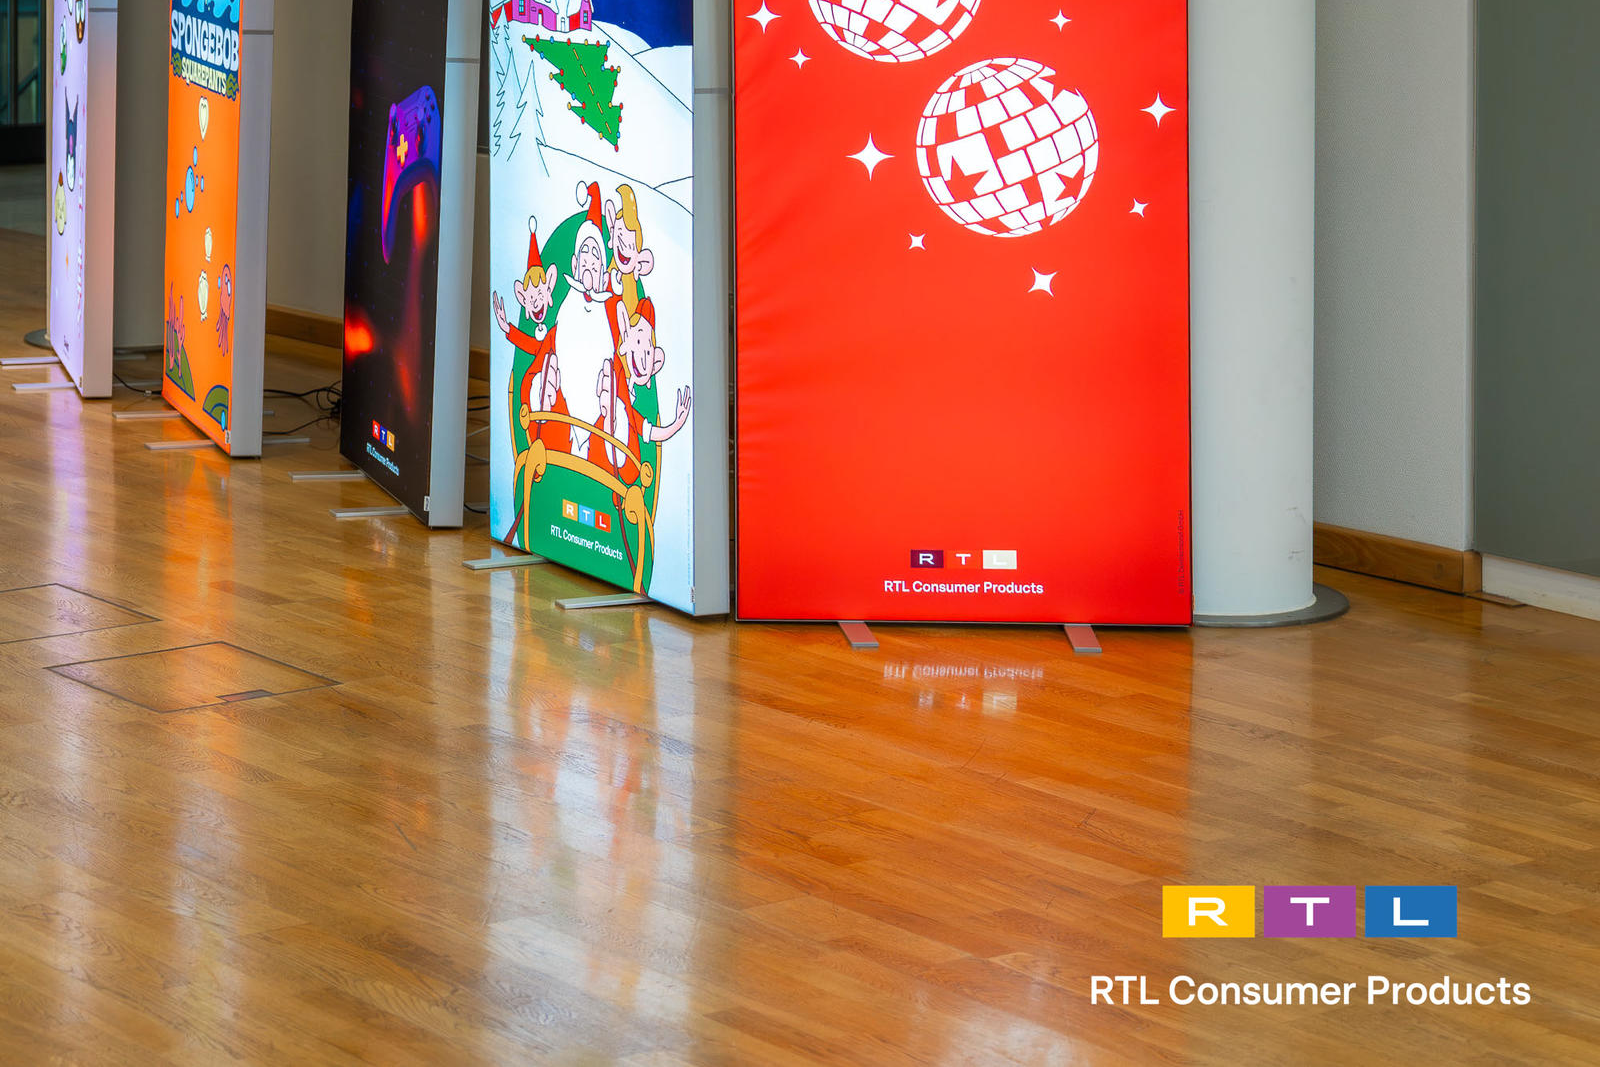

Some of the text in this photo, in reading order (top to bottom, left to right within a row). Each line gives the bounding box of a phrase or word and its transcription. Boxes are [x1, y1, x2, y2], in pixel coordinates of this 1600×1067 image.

[170, 9, 239, 72] SPONGEBOB
[181, 56, 228, 95] SQUAREPANTS
[373, 423, 394, 449] RTL
[564, 502, 608, 530] RTL
[550, 524, 624, 561] RTL Consumer Products
[918, 551, 1009, 567] RTL
[884, 580, 1044, 595] RTL Consumer Products
